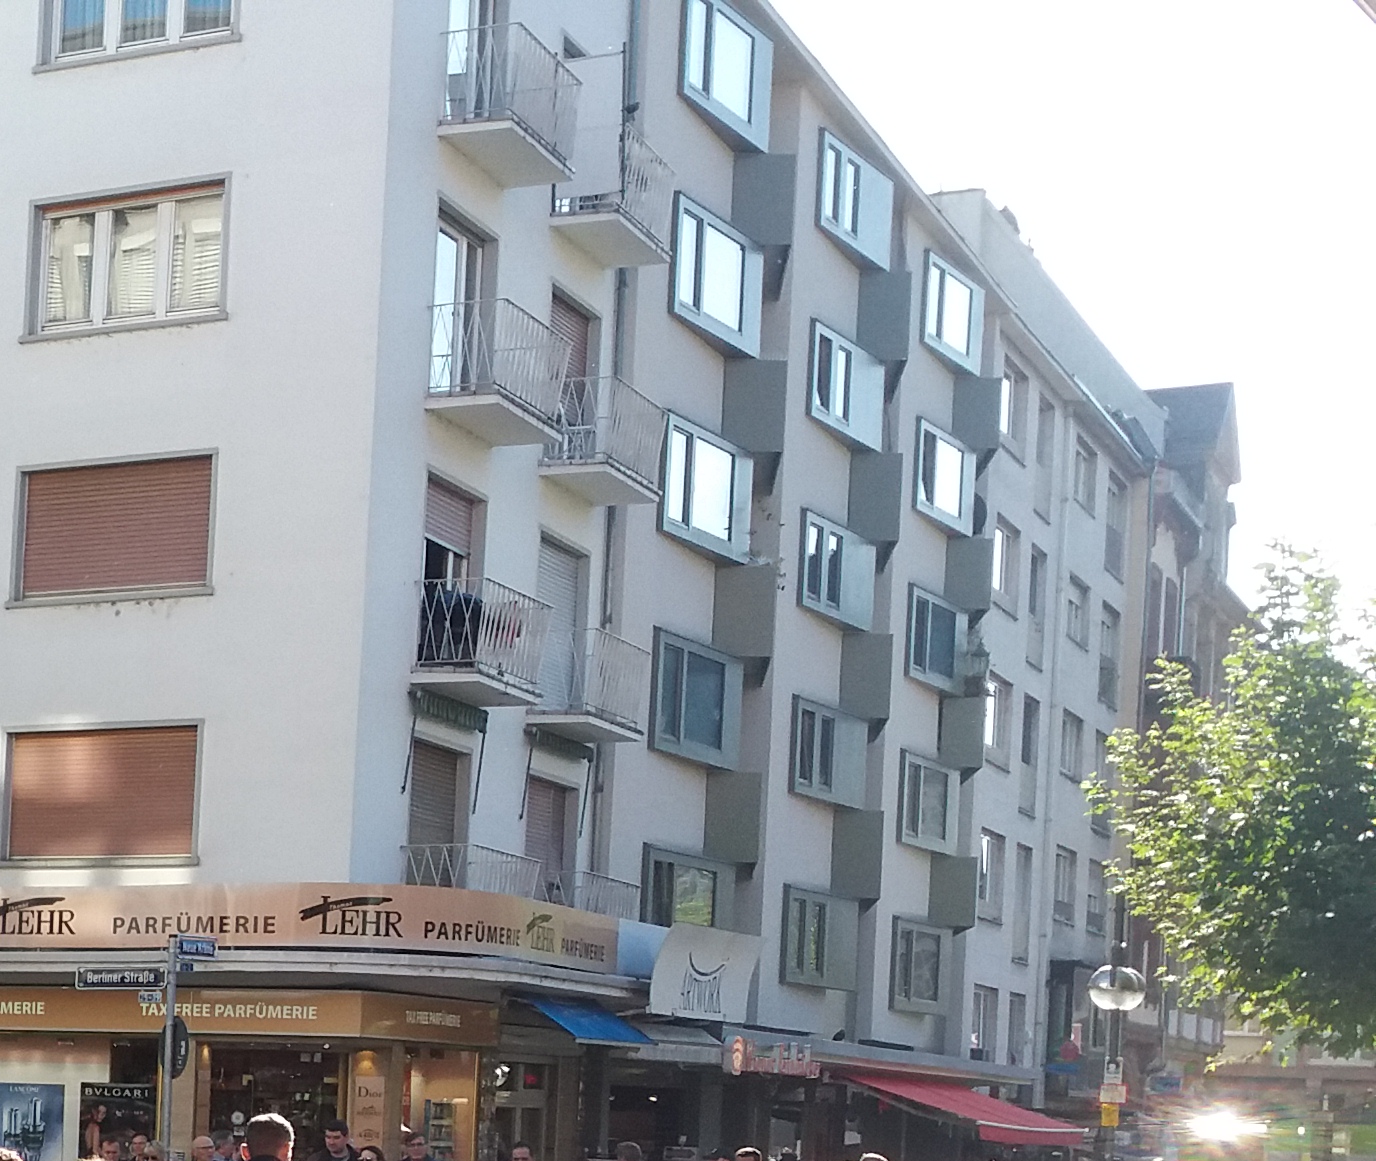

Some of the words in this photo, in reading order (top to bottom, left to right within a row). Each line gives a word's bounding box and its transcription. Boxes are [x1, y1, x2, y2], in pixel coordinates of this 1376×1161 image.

[0, 898, 76, 936] LEHR
[113, 912, 277, 934] PARFÜMERIE
[319, 896, 404, 938] LEHR
[424, 920, 521, 947] PARFÜMERIE
[86, 970, 122, 983] Berliner
[140, 1003, 168, 1016] TAX
[174, 1004, 211, 1017] FREE
[214, 1001, 318, 1020] PARFÜMERIE
